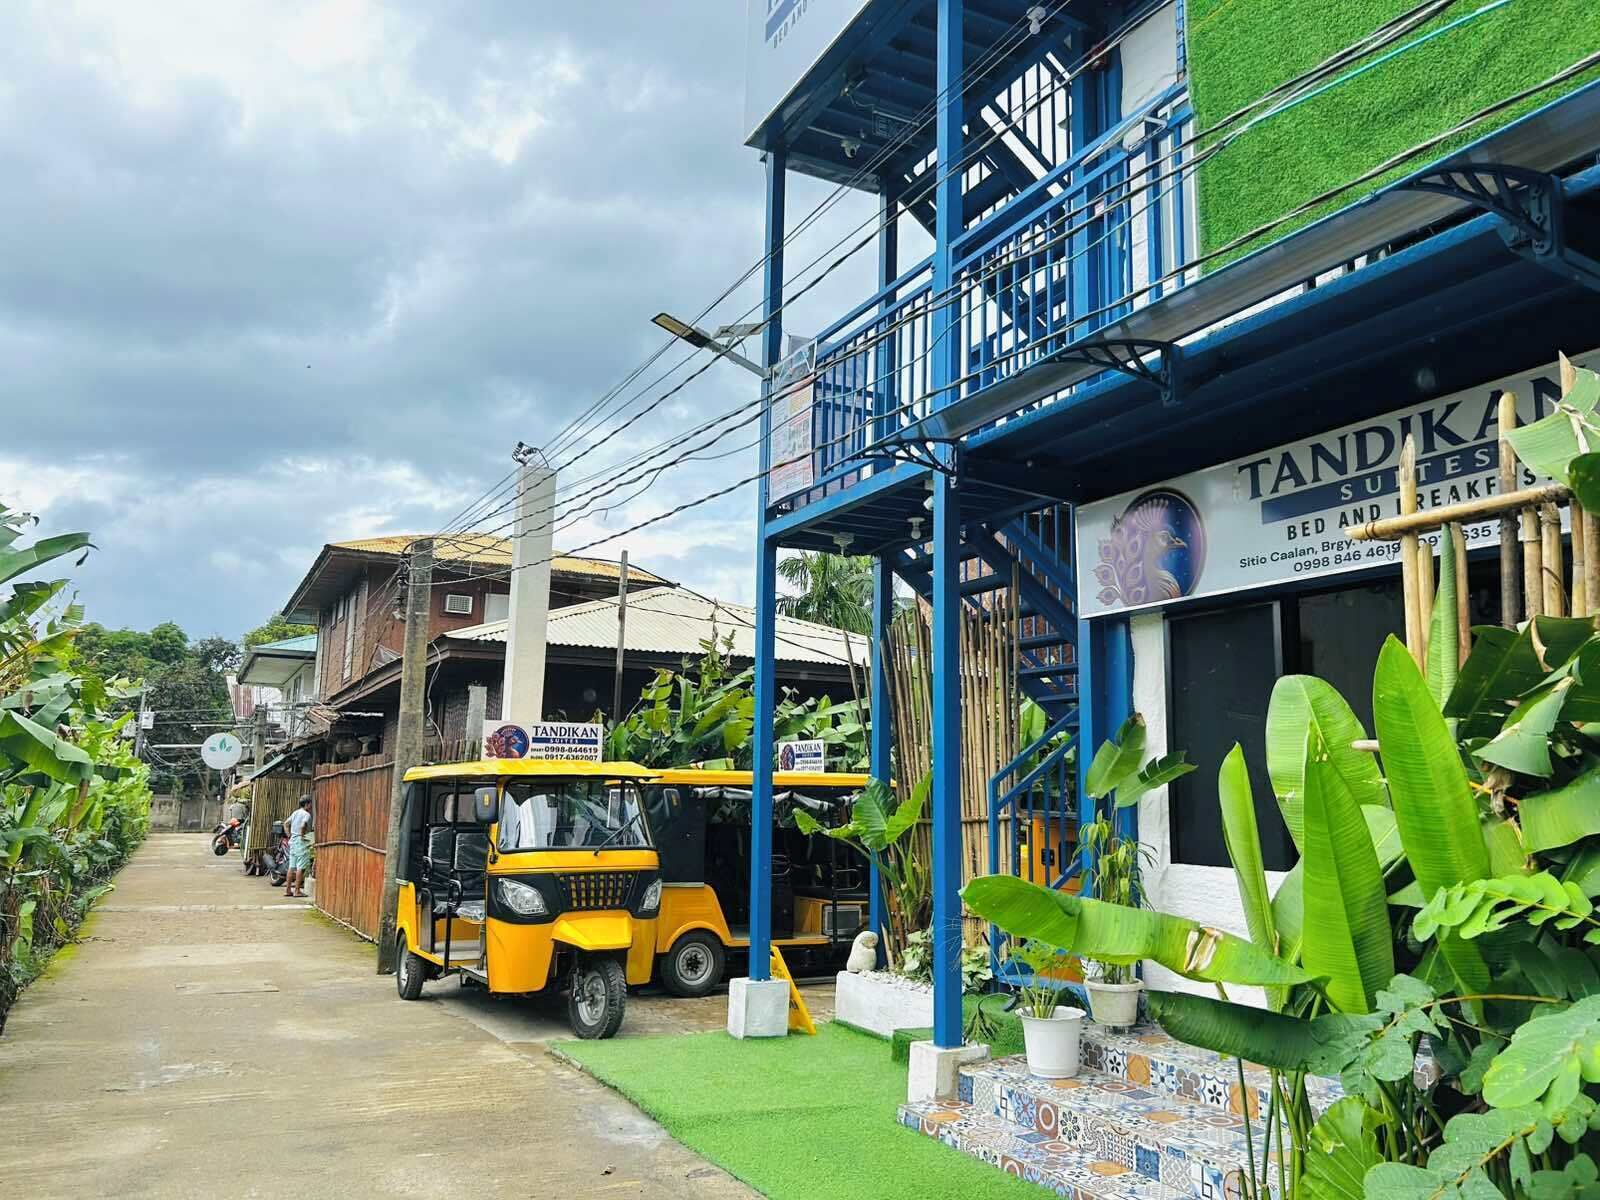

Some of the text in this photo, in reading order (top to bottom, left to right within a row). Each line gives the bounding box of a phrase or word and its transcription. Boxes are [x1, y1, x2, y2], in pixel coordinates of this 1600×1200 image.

[1287, 468, 1553, 541] BED AND REAKFS
[1239, 556, 1267, 568] Sitio
[1270, 545, 1318, 562] Caalan,
[1321, 538, 1356, 552] Brgy.
[1294, 542, 1401, 572] 0998 846 4619
[532, 726, 598, 737] TANDIKAN
